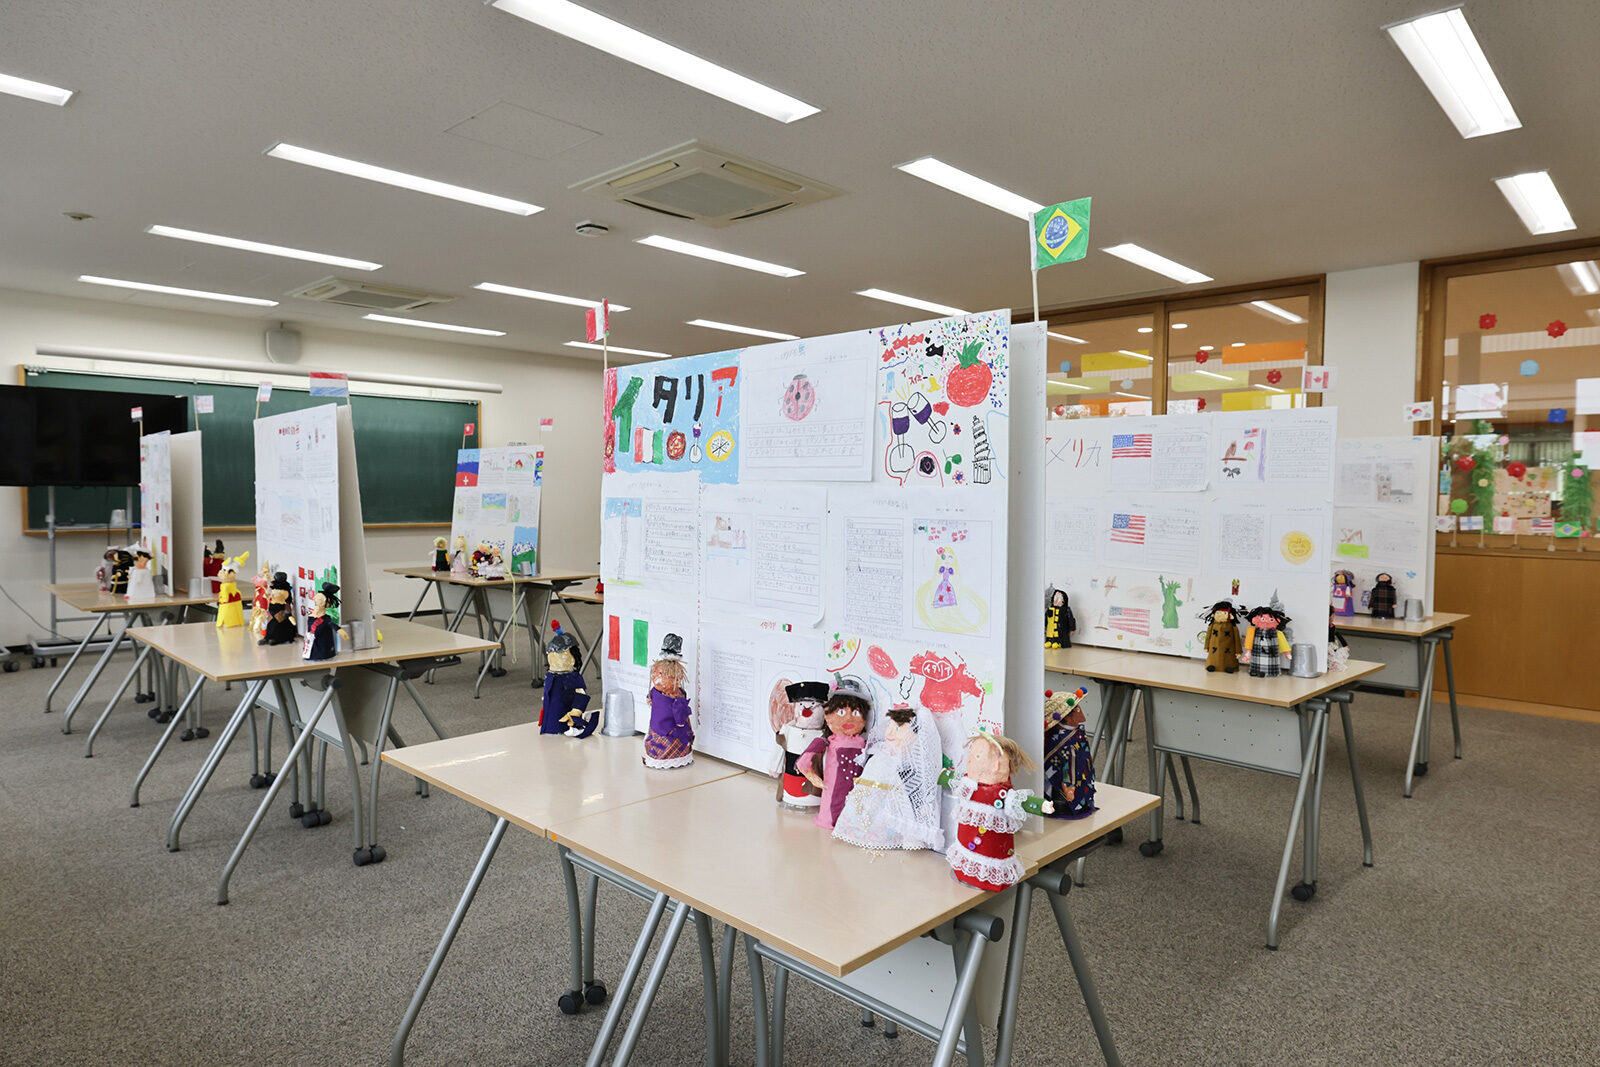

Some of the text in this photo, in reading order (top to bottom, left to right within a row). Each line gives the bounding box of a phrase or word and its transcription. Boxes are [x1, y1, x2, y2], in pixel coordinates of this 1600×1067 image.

[612, 366, 738, 453] イタリア
[1046, 437, 1102, 468] メリカ
[924, 664, 952, 677] イタリア
